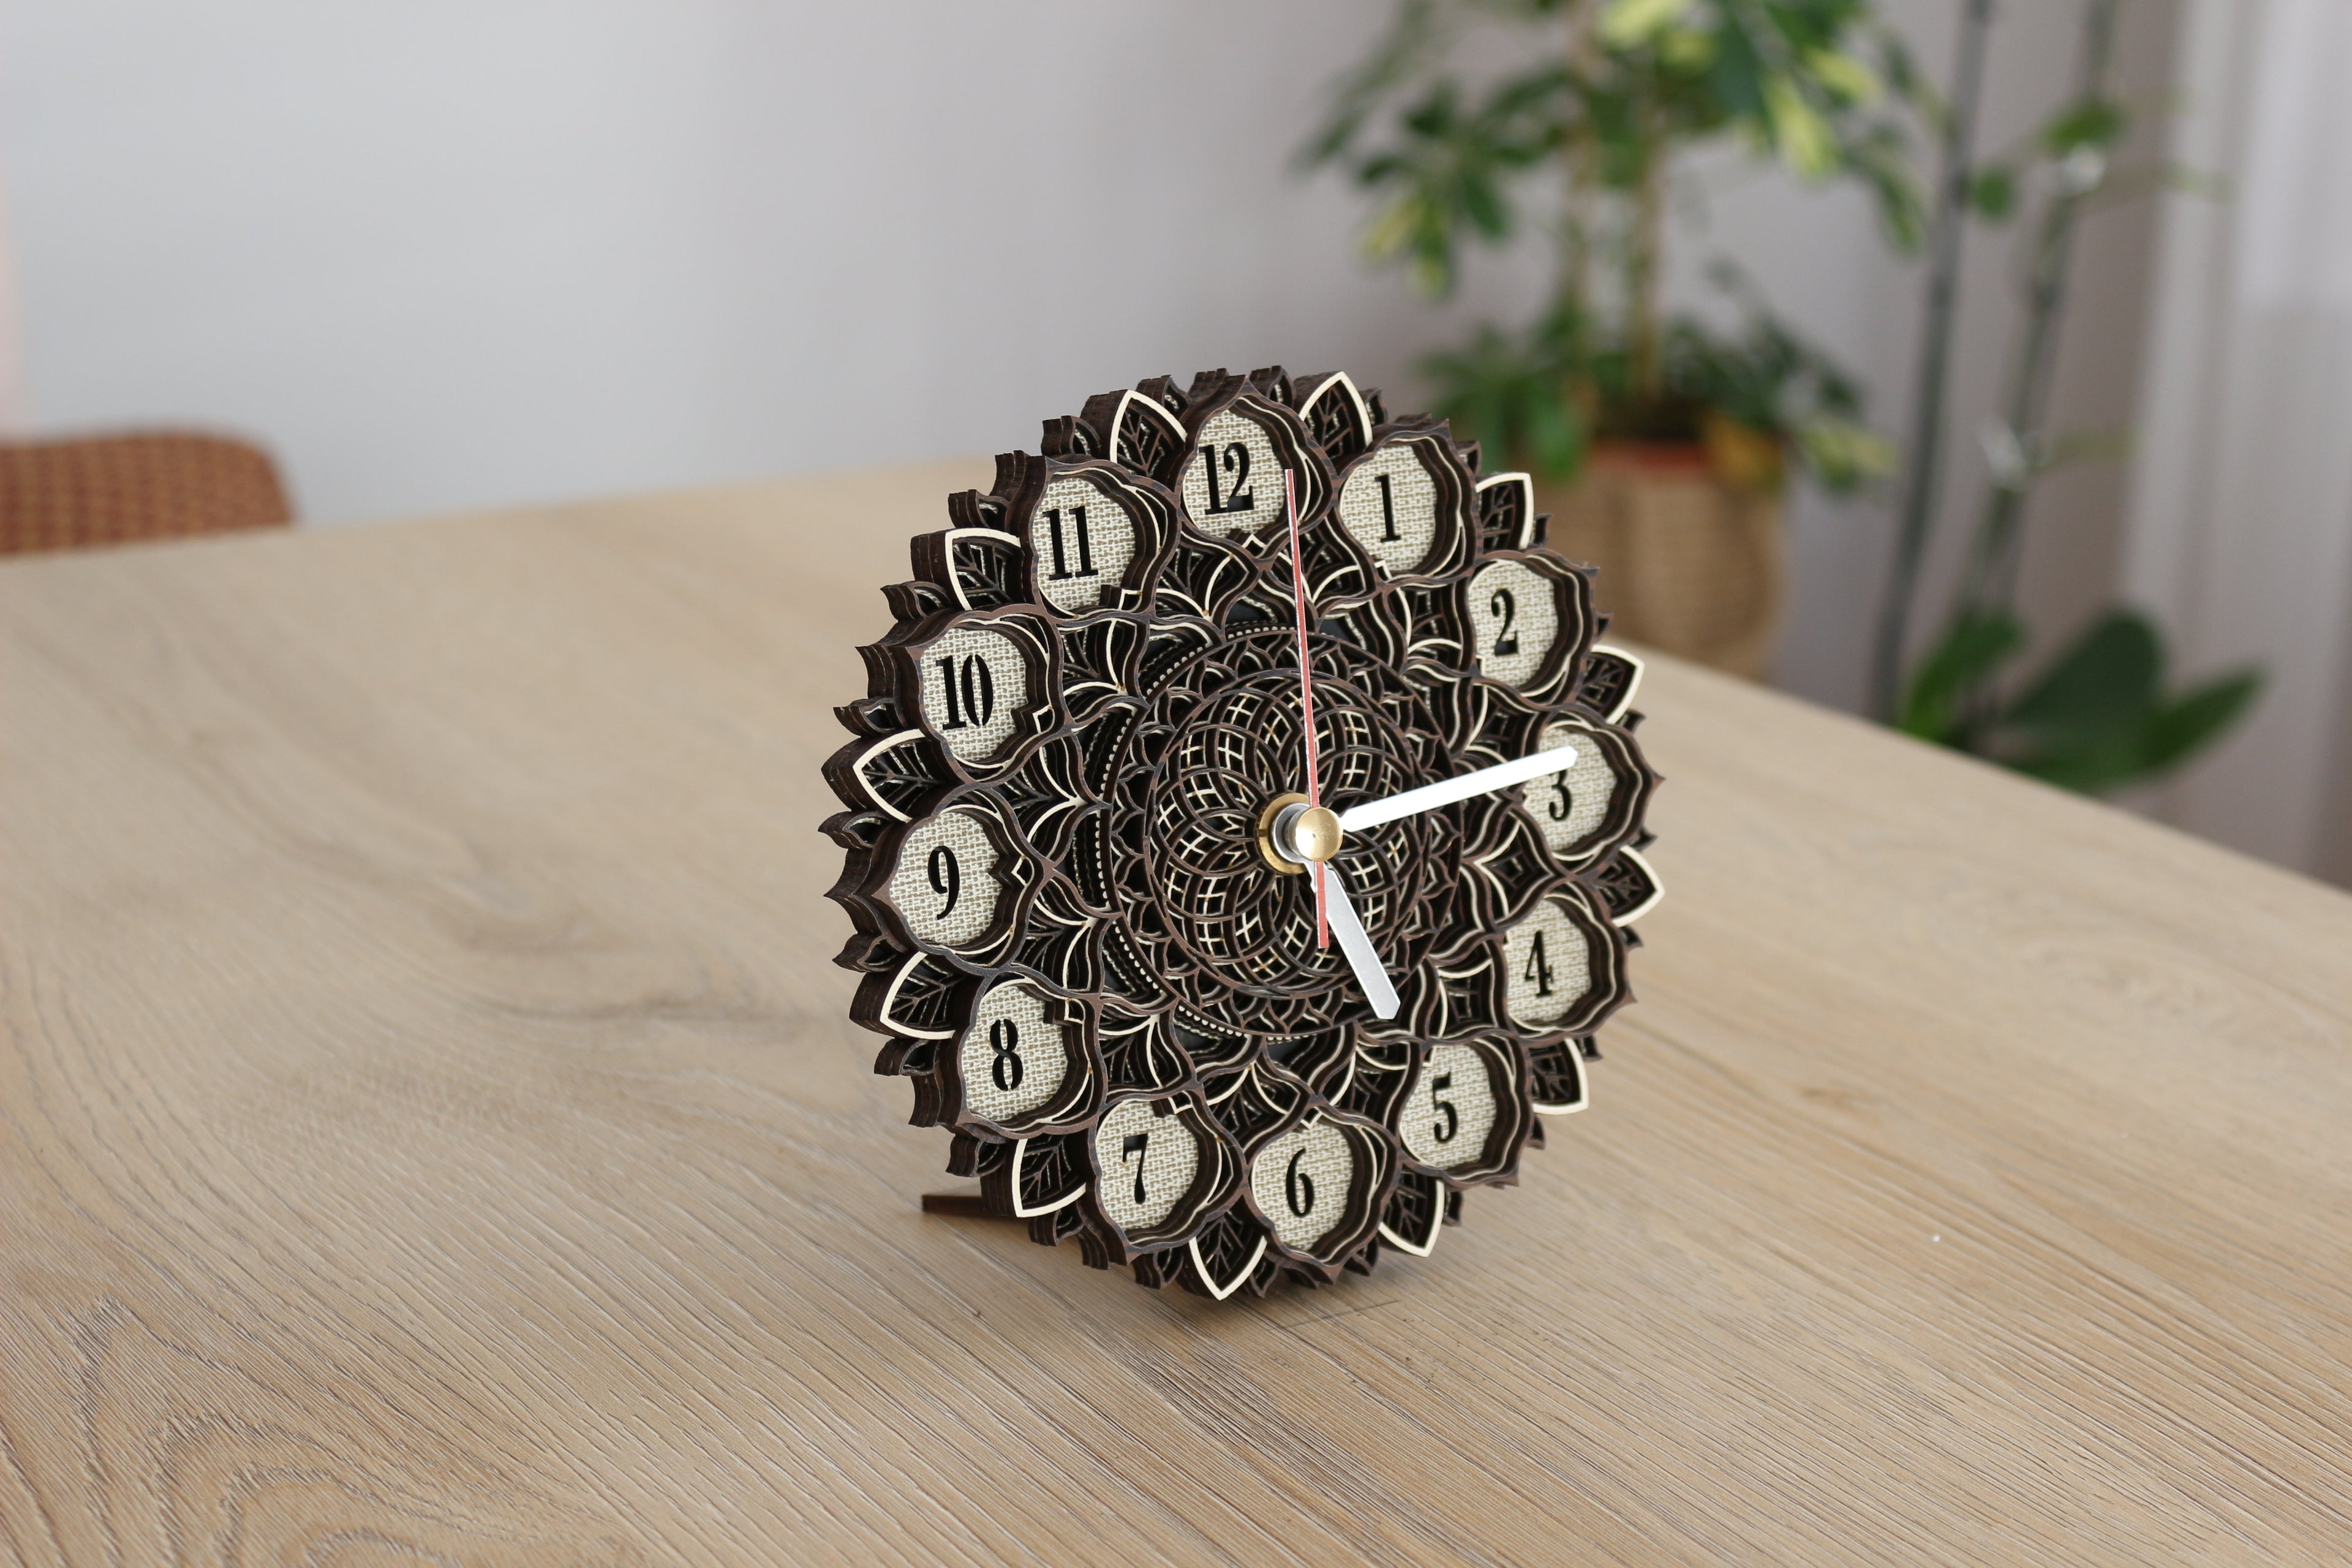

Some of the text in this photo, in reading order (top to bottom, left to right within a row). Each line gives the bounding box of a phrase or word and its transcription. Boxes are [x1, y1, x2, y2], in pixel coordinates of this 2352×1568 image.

[1198, 441, 1254, 515] 12
[1374, 473, 1401, 543] 1
[1042, 505, 1099, 581] 11
[1490, 588, 1518, 656] 2
[935, 654, 993, 731] 10
[1549, 767, 1571, 821] 3
[927, 845, 960, 921] 9
[1525, 931, 1552, 997] 4
[989, 1019, 1023, 1091] 8
[1432, 1071, 1458, 1143] 5
[1122, 1131, 1148, 1204] 7
[1286, 1148, 1314, 1218] 6
